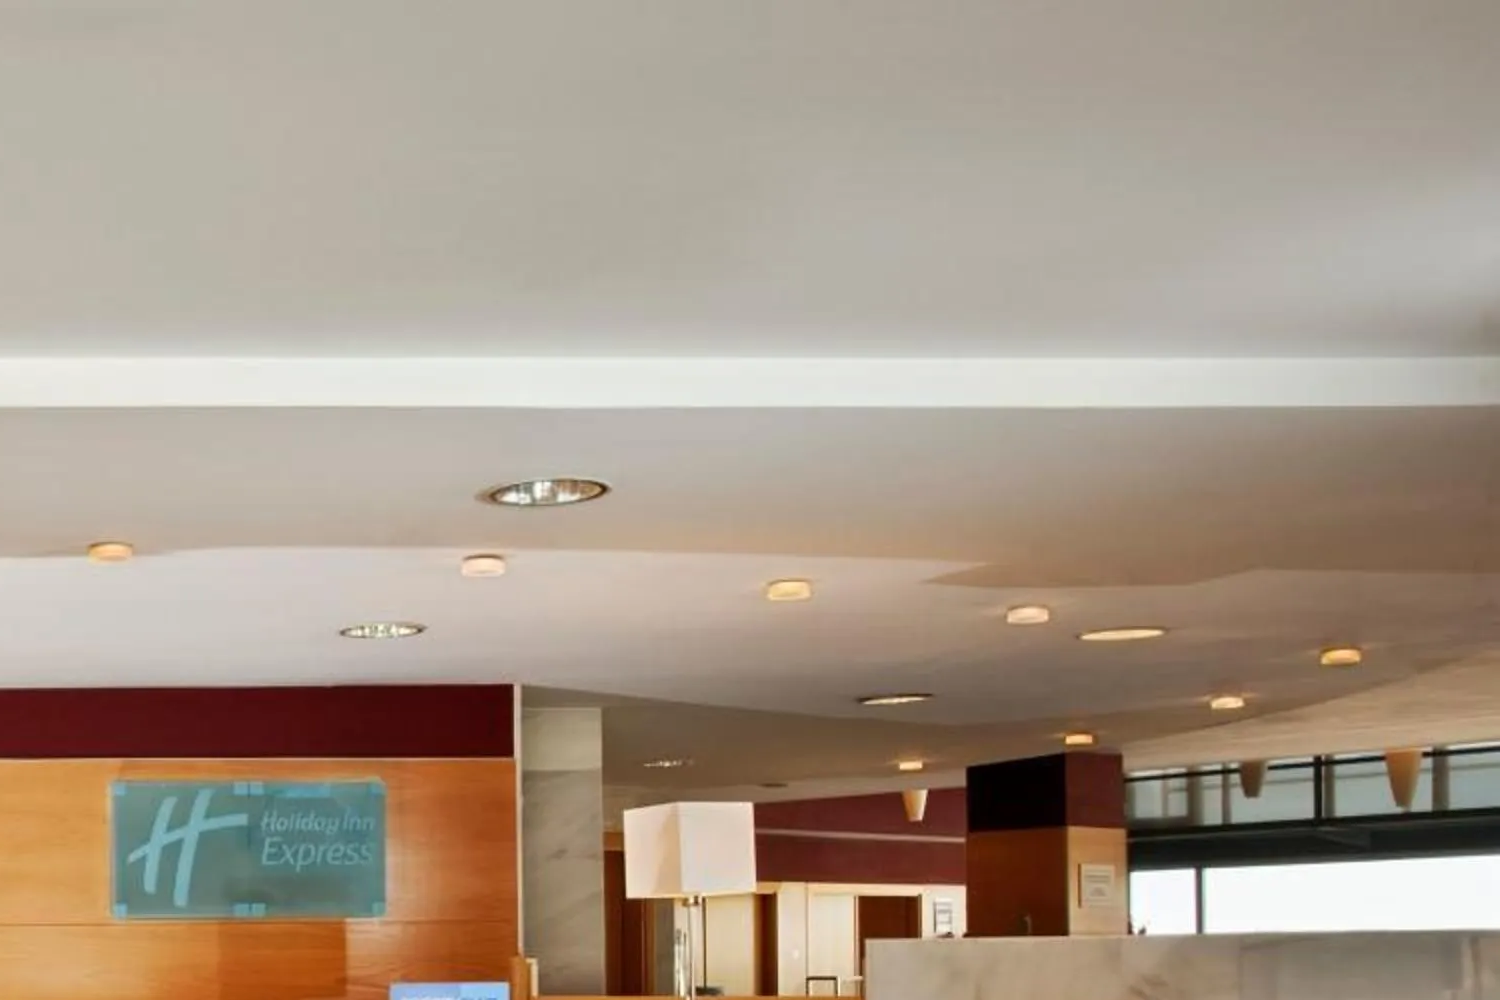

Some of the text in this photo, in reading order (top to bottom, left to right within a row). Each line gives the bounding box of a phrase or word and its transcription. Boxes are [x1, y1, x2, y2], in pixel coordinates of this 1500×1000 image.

[261, 806, 376, 836] Holiday Inn
[261, 836, 374, 873] Express
